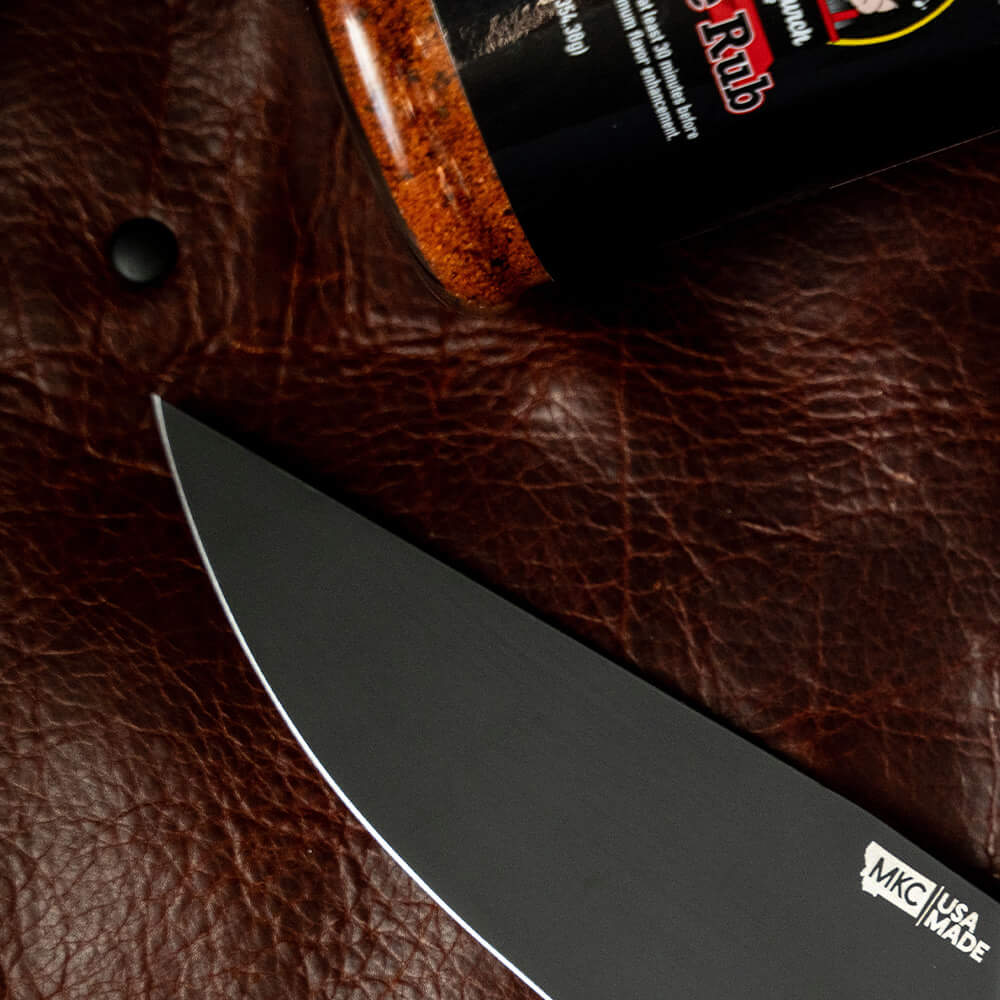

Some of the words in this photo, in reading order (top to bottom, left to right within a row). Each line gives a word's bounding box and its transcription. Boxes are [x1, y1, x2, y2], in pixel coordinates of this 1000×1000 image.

[642, 10, 666, 43] least
[626, 29, 650, 65] flavor
[653, 41, 673, 59] 30
[696, 9, 775, 114] Rub
[658, 59, 686, 106] minutes
[676, 103, 700, 140] before
[868, 857, 927, 907] MKC
[937, 893, 979, 933] USA
[924, 909, 991, 963] MADE
